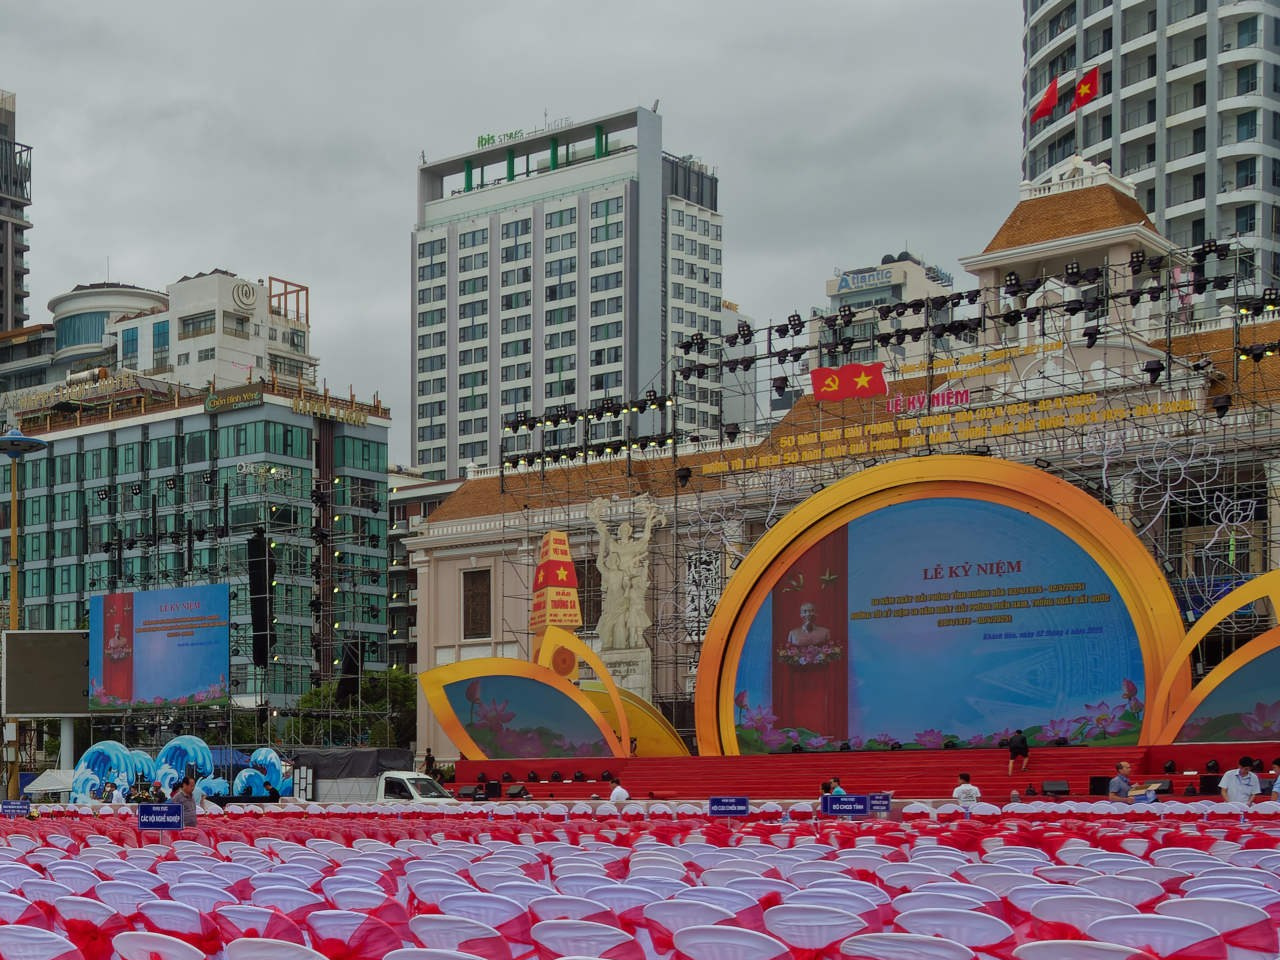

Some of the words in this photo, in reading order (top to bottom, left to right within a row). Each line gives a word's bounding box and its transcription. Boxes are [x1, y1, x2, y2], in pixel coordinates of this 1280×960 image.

[477, 134, 496, 149] ibis
[838, 269, 893, 292] Atlantic
[780, 435, 795, 448] 50
[783, 451, 799, 464] 50
[947, 561, 972, 578] KỶ
[976, 559, 1022, 577] NIỆM
[140, 814, 149, 823] CÁC
